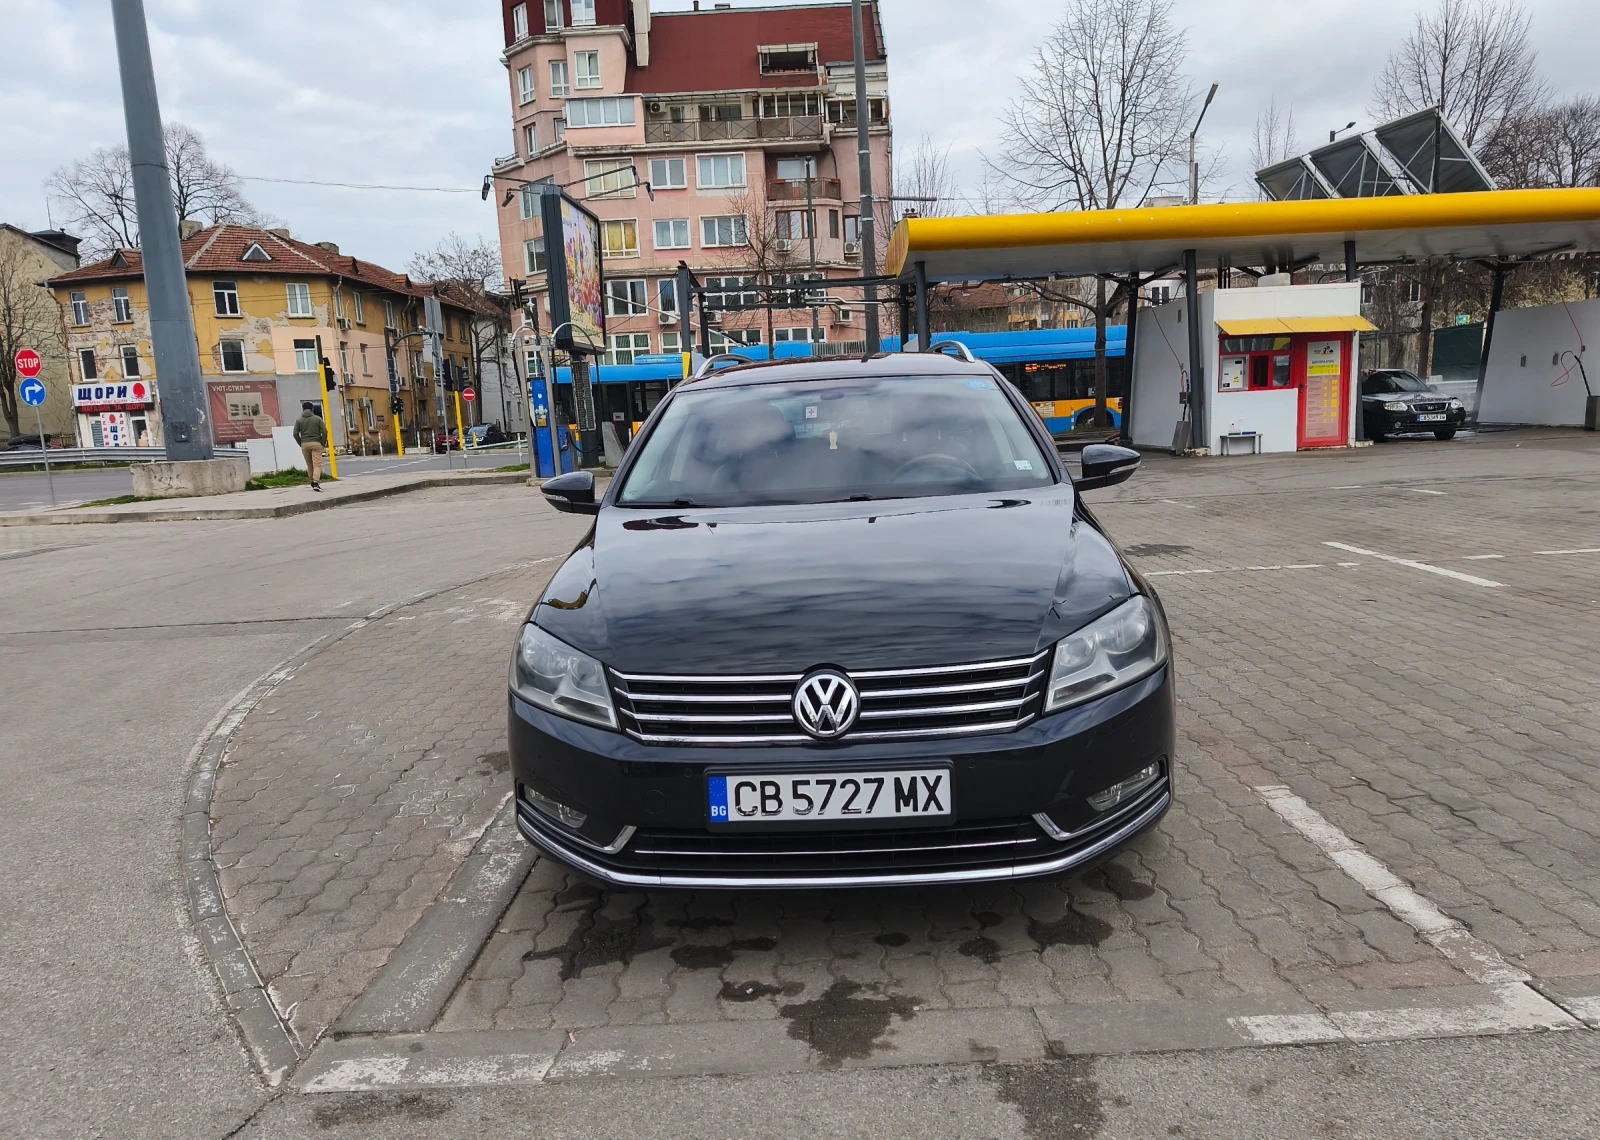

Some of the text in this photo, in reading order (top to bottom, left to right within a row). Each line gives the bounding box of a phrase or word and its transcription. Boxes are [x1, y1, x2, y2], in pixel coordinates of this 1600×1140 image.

[17, 358, 38, 368] STOP
[78, 386, 127, 401] ЩОРИ
[81, 405, 111, 413] МАГАЗИН
[734, 775, 944, 817] CB 5727 MX
[711, 805, 727, 817] BG
